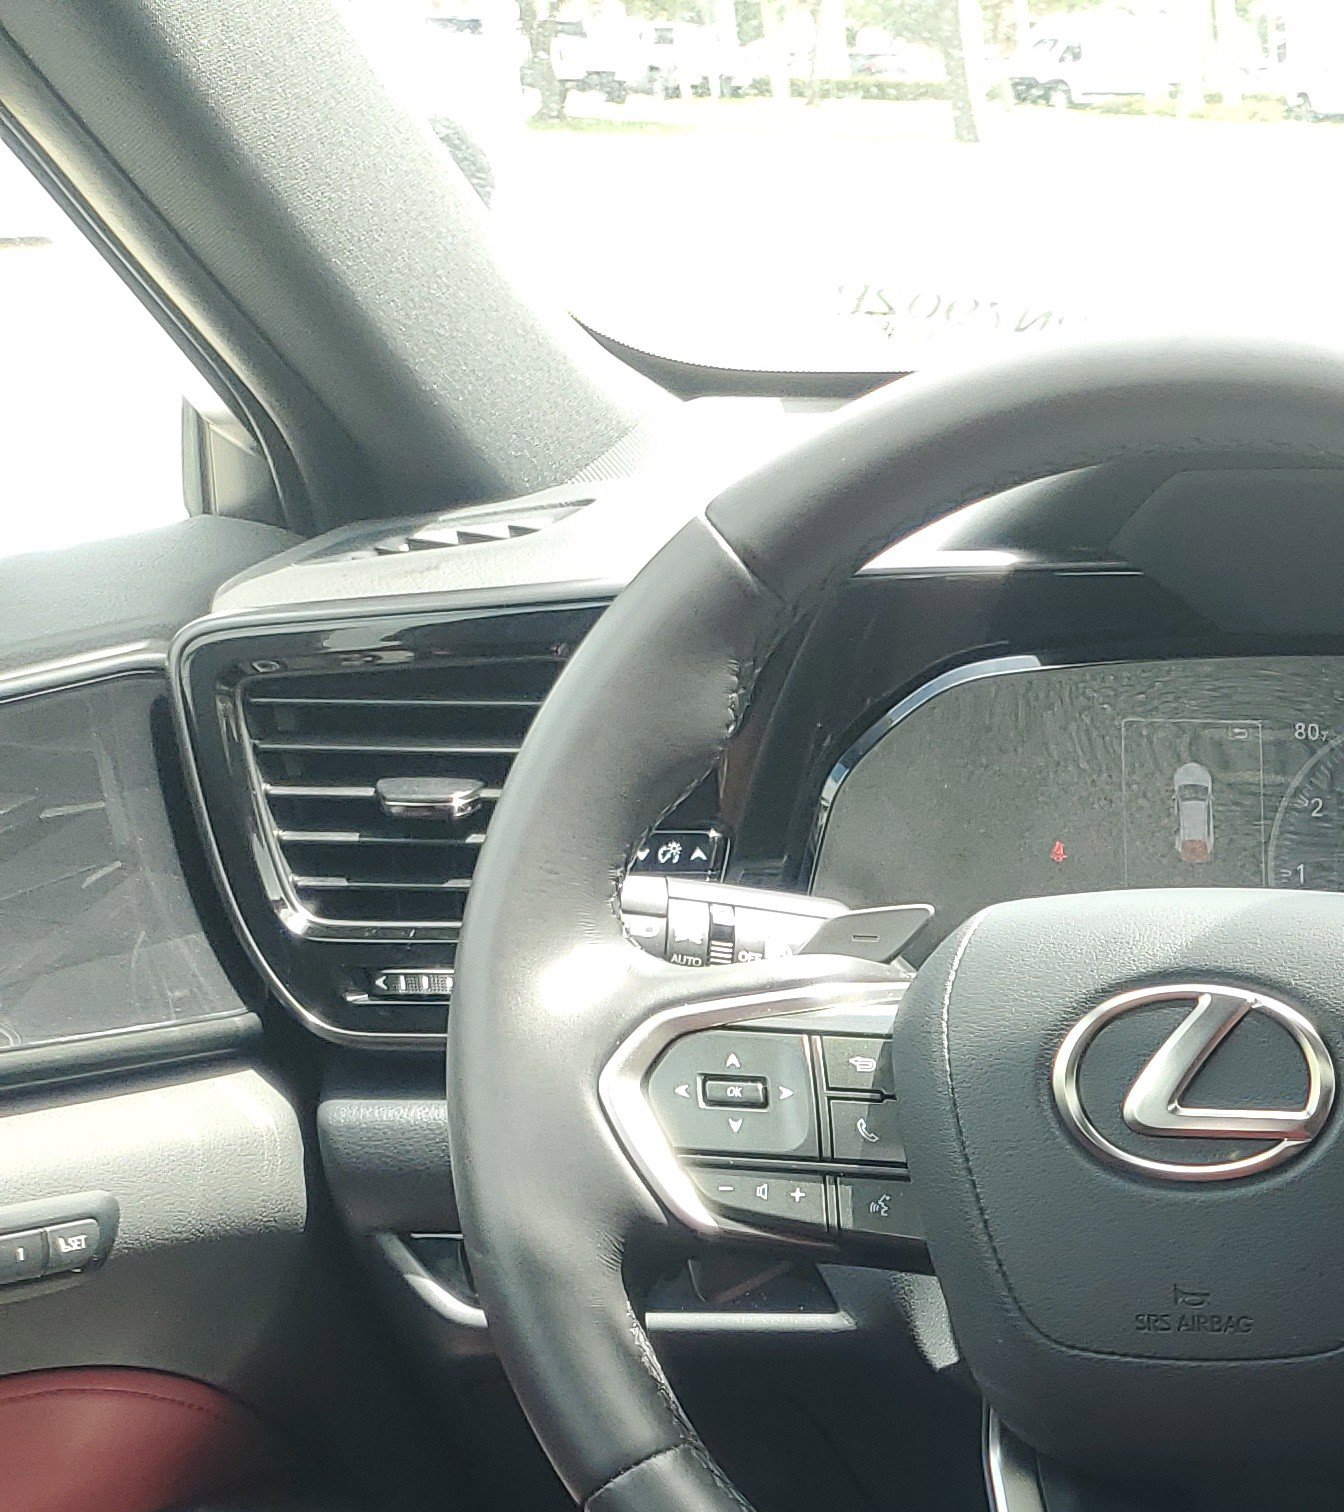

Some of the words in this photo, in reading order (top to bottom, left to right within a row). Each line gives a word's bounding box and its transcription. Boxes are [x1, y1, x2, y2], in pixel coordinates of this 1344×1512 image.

[1311, 797, 1324, 818] 2
[670, 953, 703, 967] AUTO
[726, 1085, 743, 1099] OK
[1135, 1313, 1172, 1333] SRS
[1177, 1313, 1254, 1334] AIRBAG
